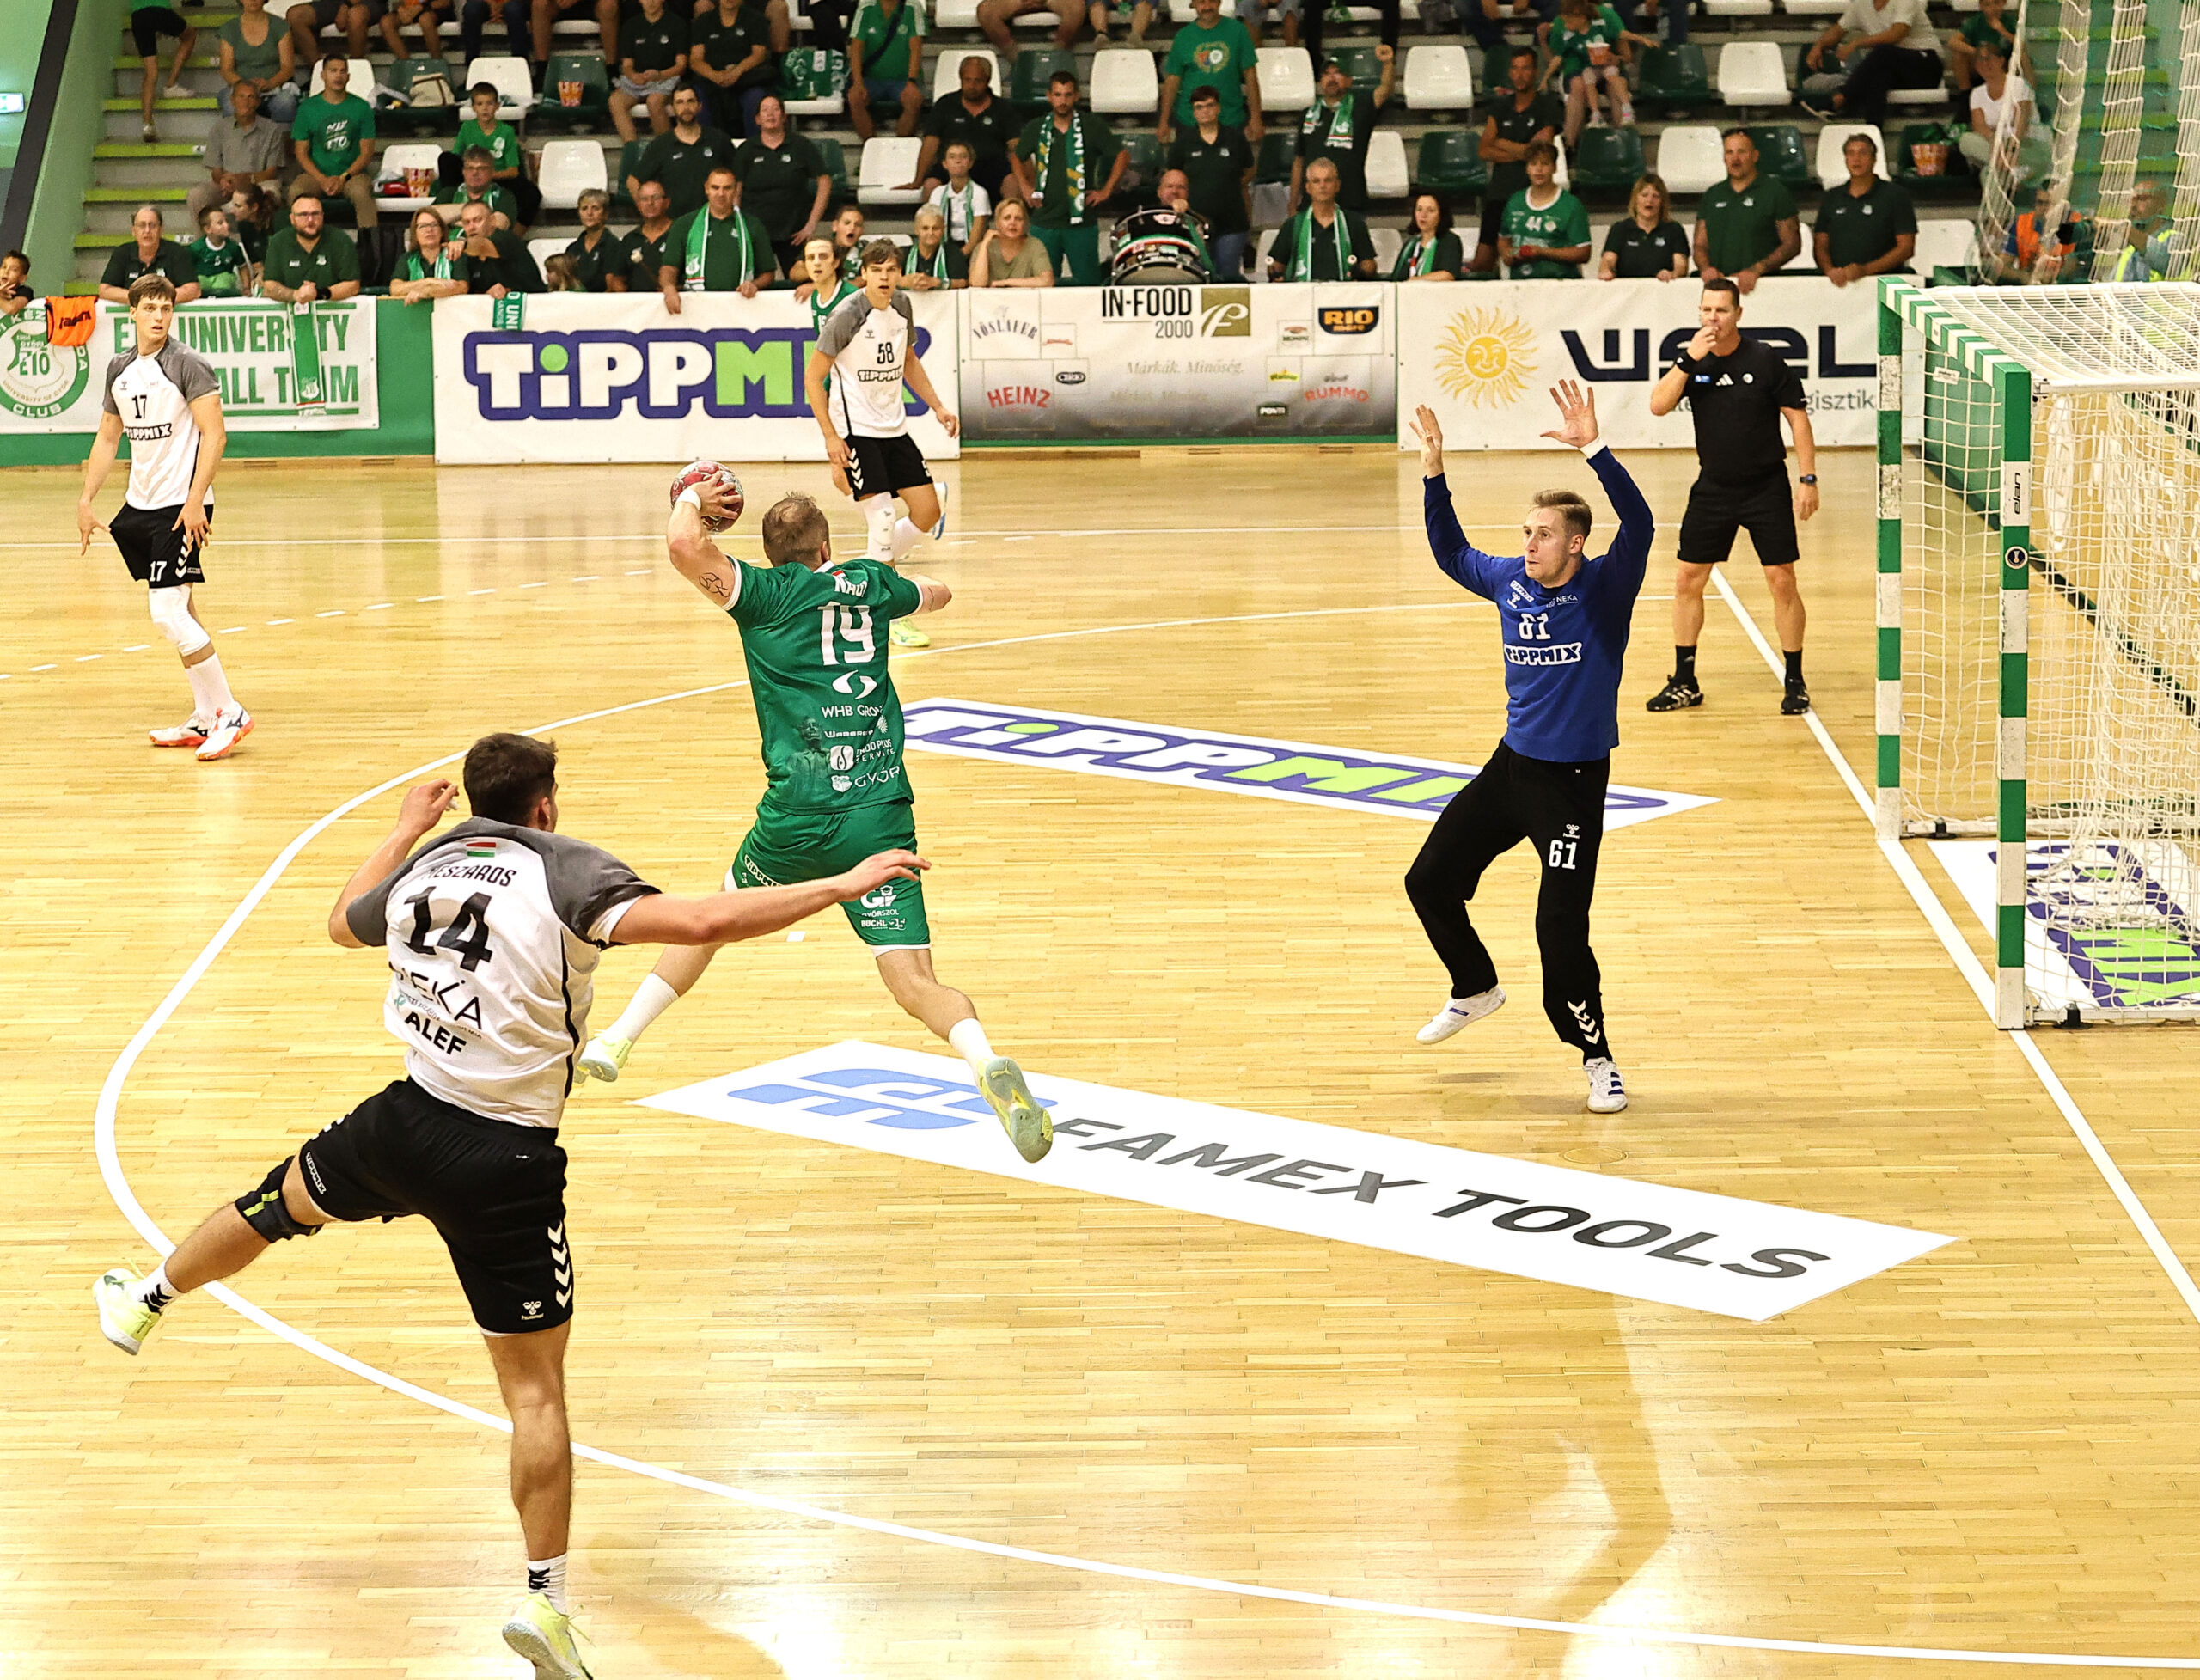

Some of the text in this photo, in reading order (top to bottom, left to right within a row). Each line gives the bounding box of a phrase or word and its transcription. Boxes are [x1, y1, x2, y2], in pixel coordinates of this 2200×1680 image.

[1102, 288, 1192, 317] IN-FOOD
[1323, 310, 1374, 325] RIO
[178, 314, 350, 353] UNIVERTY
[1155, 320, 1193, 338] 2000
[877, 342, 895, 364] 58
[987, 386, 1051, 408] HEINZ
[1304, 387, 1369, 402] RUMMO
[13, 404, 62, 418] CLUB
[132, 394, 147, 419] 17
[150, 560, 167, 582] 17
[1556, 594, 1578, 603] NEKA
[817, 602, 876, 666] 19
[1519, 613, 1551, 640] 61
[822, 705, 853, 718] WHB
[877, 738, 892, 749] PLUS
[1549, 840, 1577, 870] 61
[403, 886, 492, 972] 14
[405, 1011, 467, 1054] ALEF
[1052, 1118, 1831, 1278] FAMEX TOOLS
